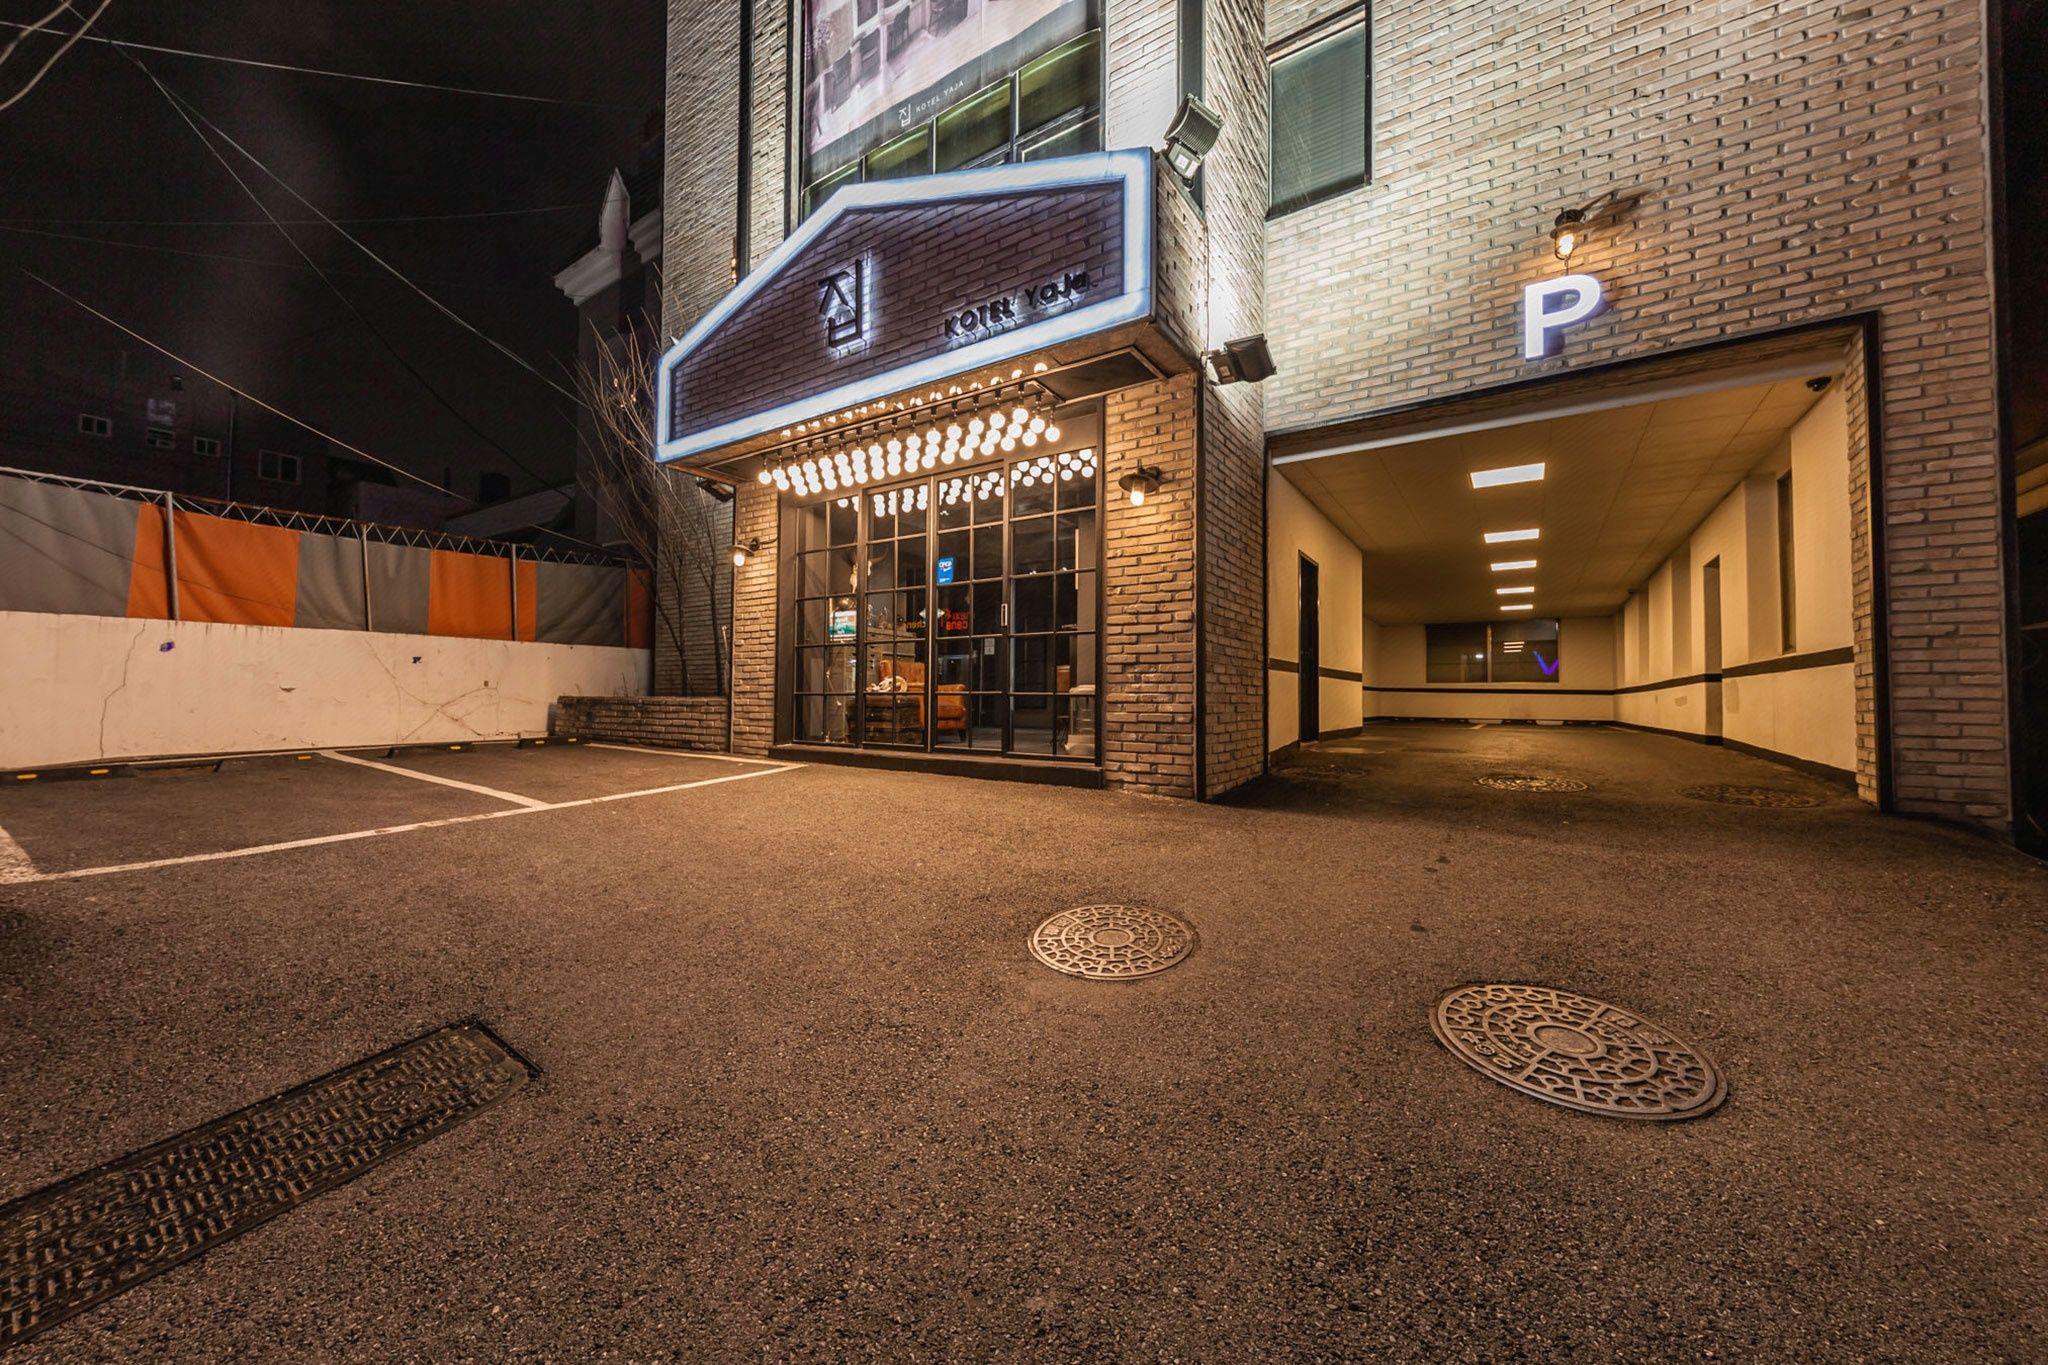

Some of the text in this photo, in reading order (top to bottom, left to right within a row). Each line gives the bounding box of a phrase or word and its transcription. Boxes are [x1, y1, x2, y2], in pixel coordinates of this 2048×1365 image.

[943, 80, 964, 97] YAJA
[945, 297, 1015, 338] KOTEL
[1525, 274, 1601, 359] P
